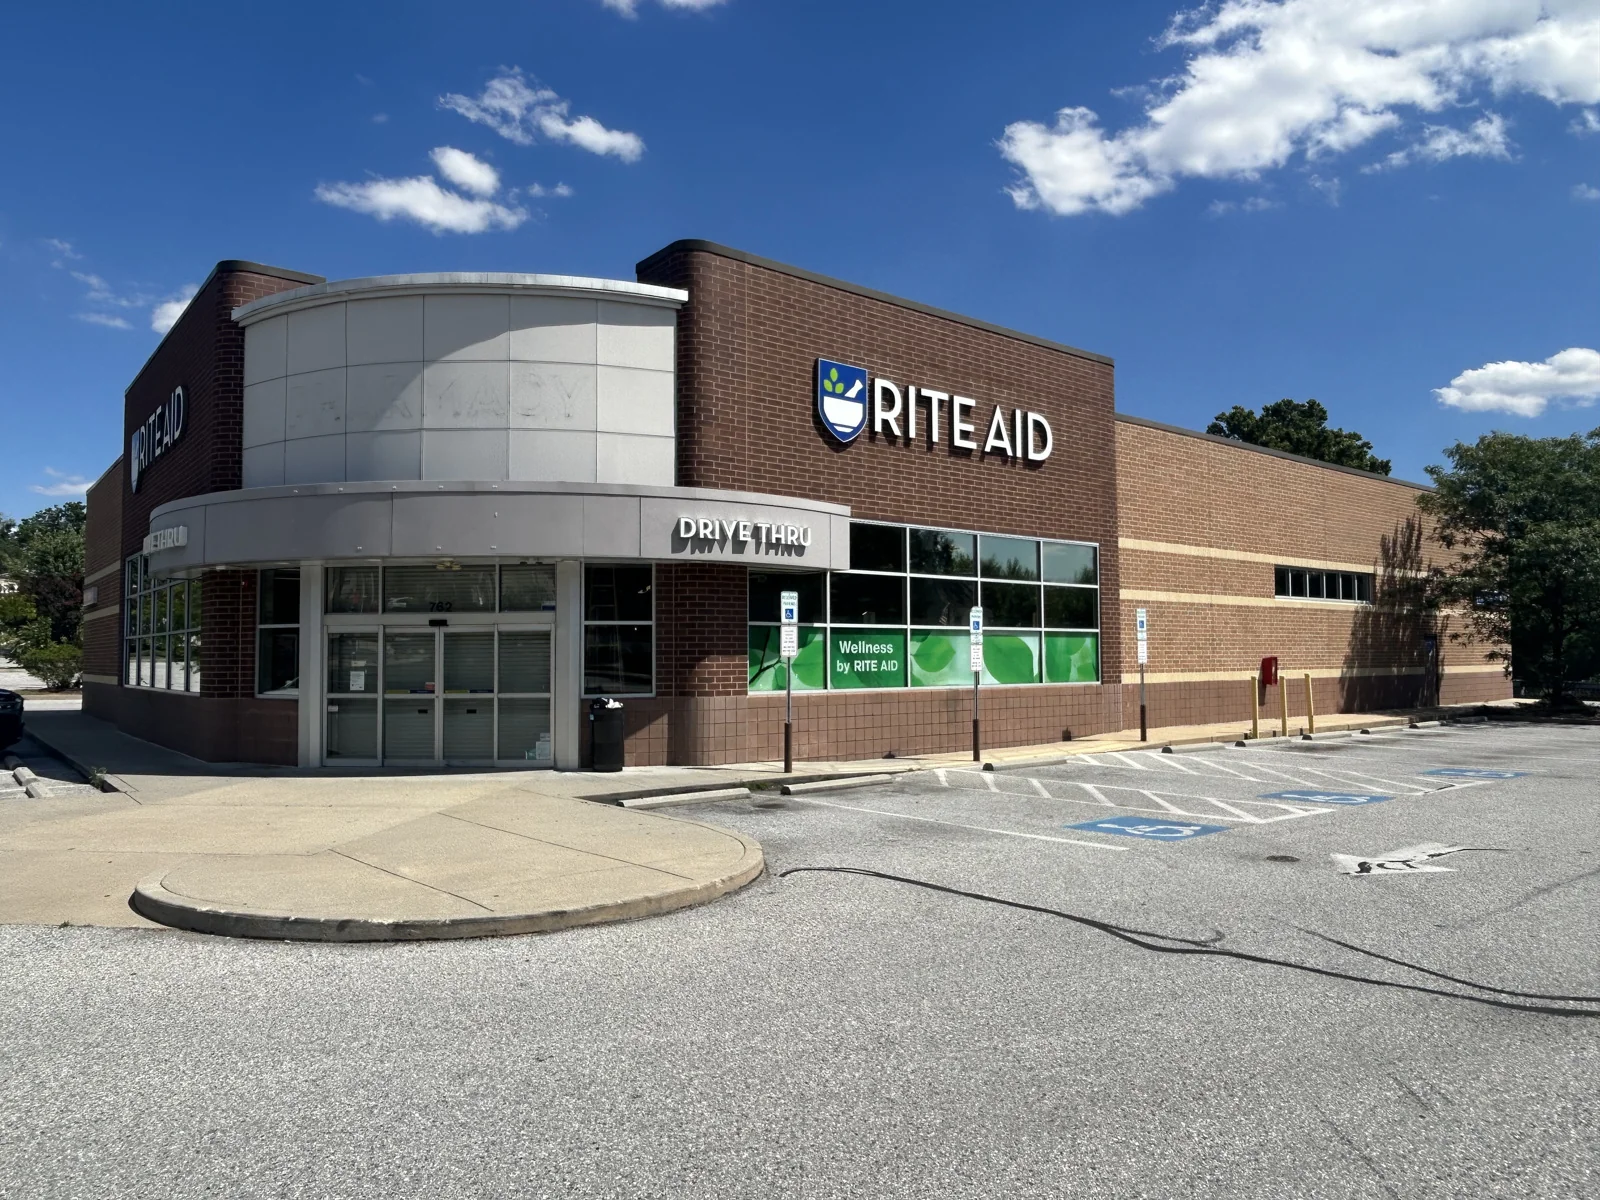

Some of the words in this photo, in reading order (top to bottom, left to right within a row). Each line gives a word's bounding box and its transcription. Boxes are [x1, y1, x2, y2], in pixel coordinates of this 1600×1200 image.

[138, 405, 162, 470] RITE
[162, 385, 184, 452] AID
[873, 377, 977, 450] RITE
[984, 404, 1053, 461] AID
[679, 517, 751, 541] DRIVE
[757, 523, 812, 547] THRU
[429, 601, 453, 612] 762
[839, 640, 894, 654] Wellness
[836, 660, 850, 674] by
[854, 660, 878, 672] RITE
[880, 660, 898, 672] AID
